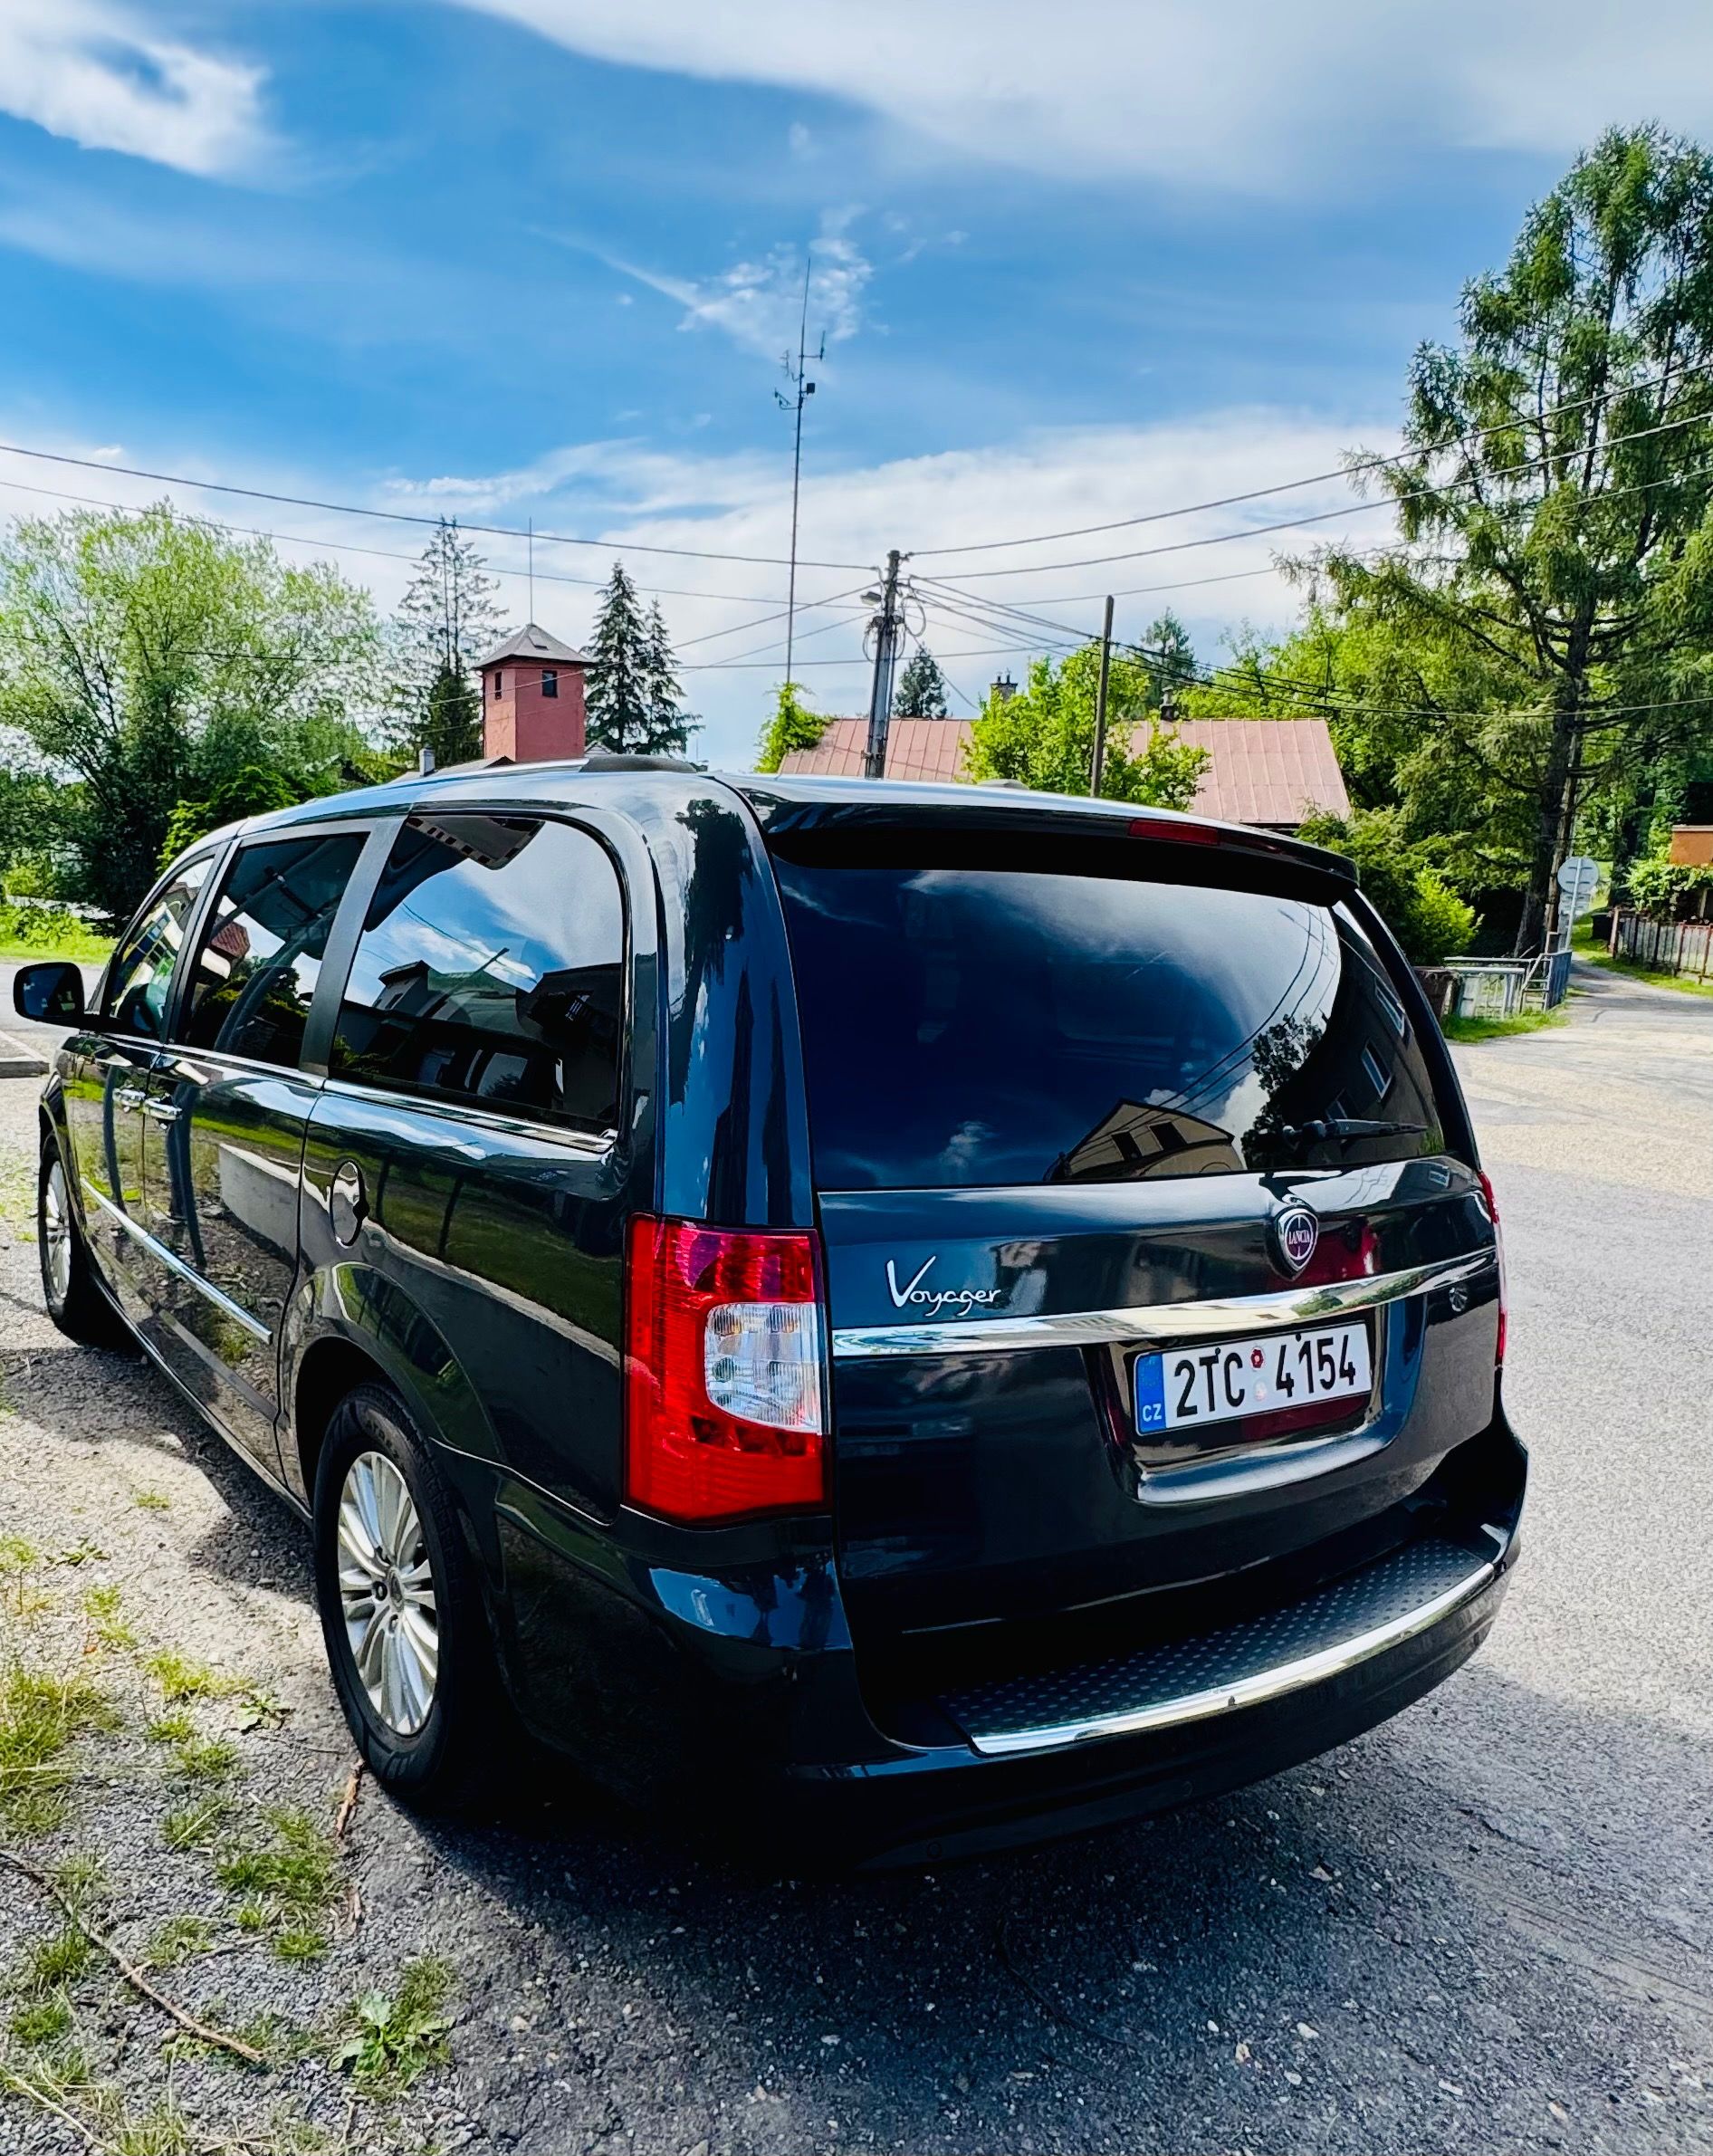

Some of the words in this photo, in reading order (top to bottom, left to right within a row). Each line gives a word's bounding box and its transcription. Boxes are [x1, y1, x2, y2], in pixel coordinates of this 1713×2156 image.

[1288, 1229, 1310, 1245] LANCIA
[886, 1255, 1001, 1317] Voyager
[1174, 1352, 1245, 1418] 2TC
[1276, 1334, 1356, 1398] 4154
[1142, 1404, 1163, 1423] CZ
